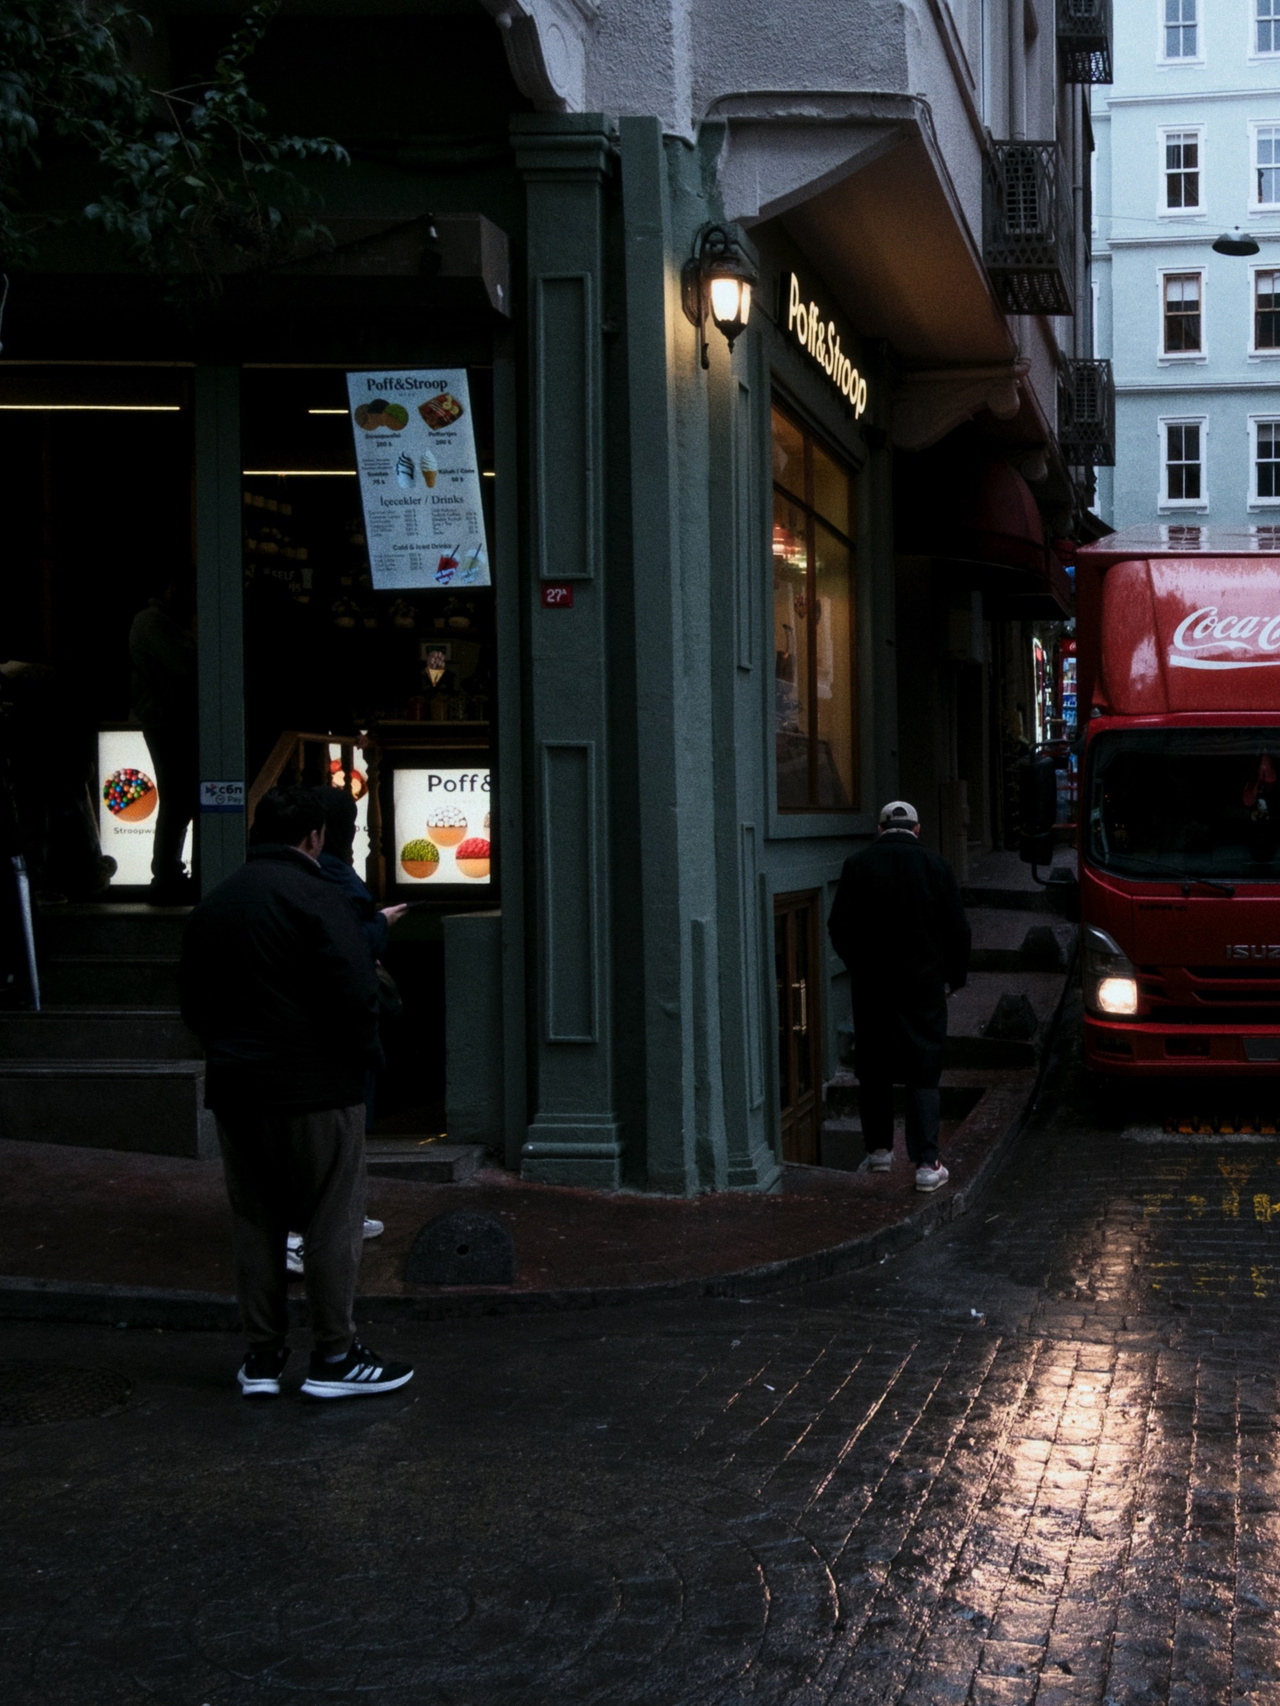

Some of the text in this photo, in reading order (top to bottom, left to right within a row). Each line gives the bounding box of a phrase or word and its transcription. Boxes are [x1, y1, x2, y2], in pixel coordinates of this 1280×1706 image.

[788, 271, 867, 420] Poff&Stroop
[366, 376, 448, 392] Poff&Stroop
[431, 494, 464, 505] Drinks
[431, 542, 452, 550] Drinks
